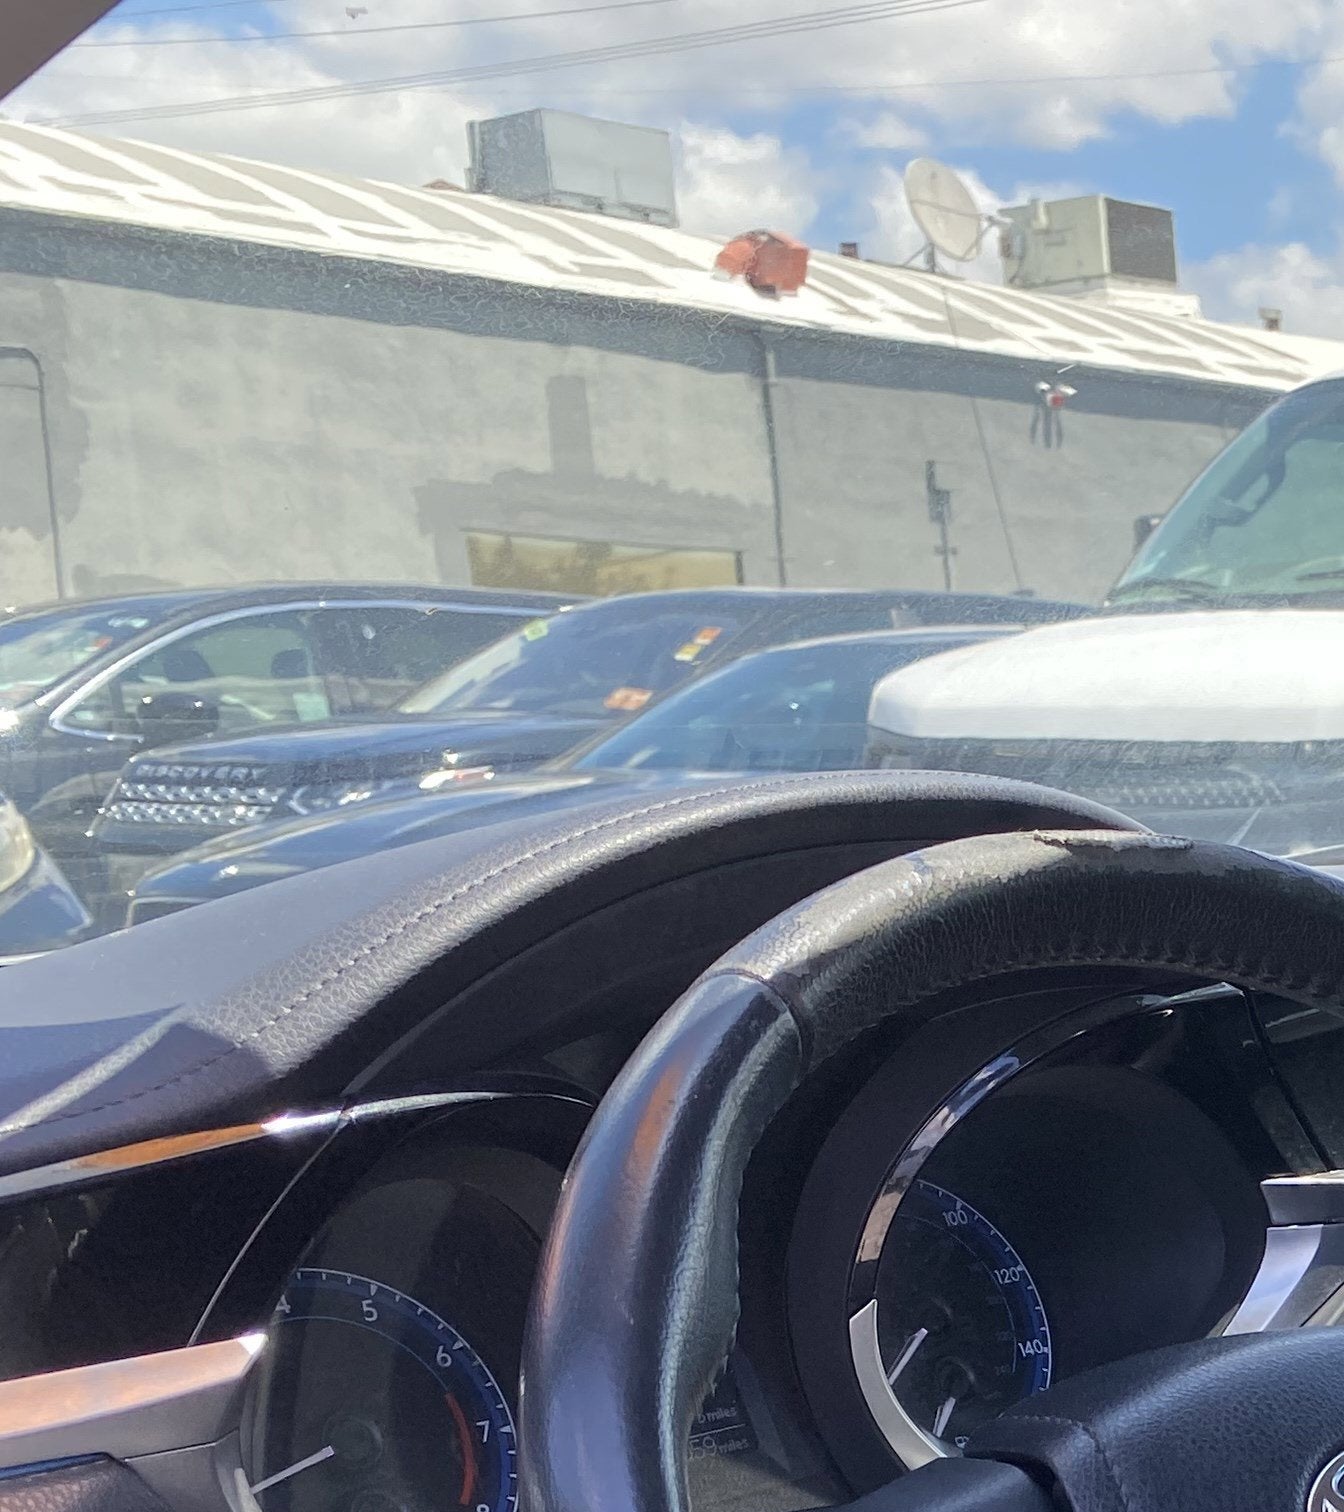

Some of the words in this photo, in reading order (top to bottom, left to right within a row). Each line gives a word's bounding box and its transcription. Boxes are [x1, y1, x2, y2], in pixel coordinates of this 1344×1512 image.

[942, 1210, 968, 1226] 100
[994, 1267, 1020, 1285] 120
[362, 1300, 378, 1322] 5
[436, 1345, 452, 1367] 6
[1018, 1339, 1043, 1357] 140
[707, 1407, 738, 1423] miles
[476, 1420, 490, 1443] 7
[719, 1438, 750, 1454] miles
